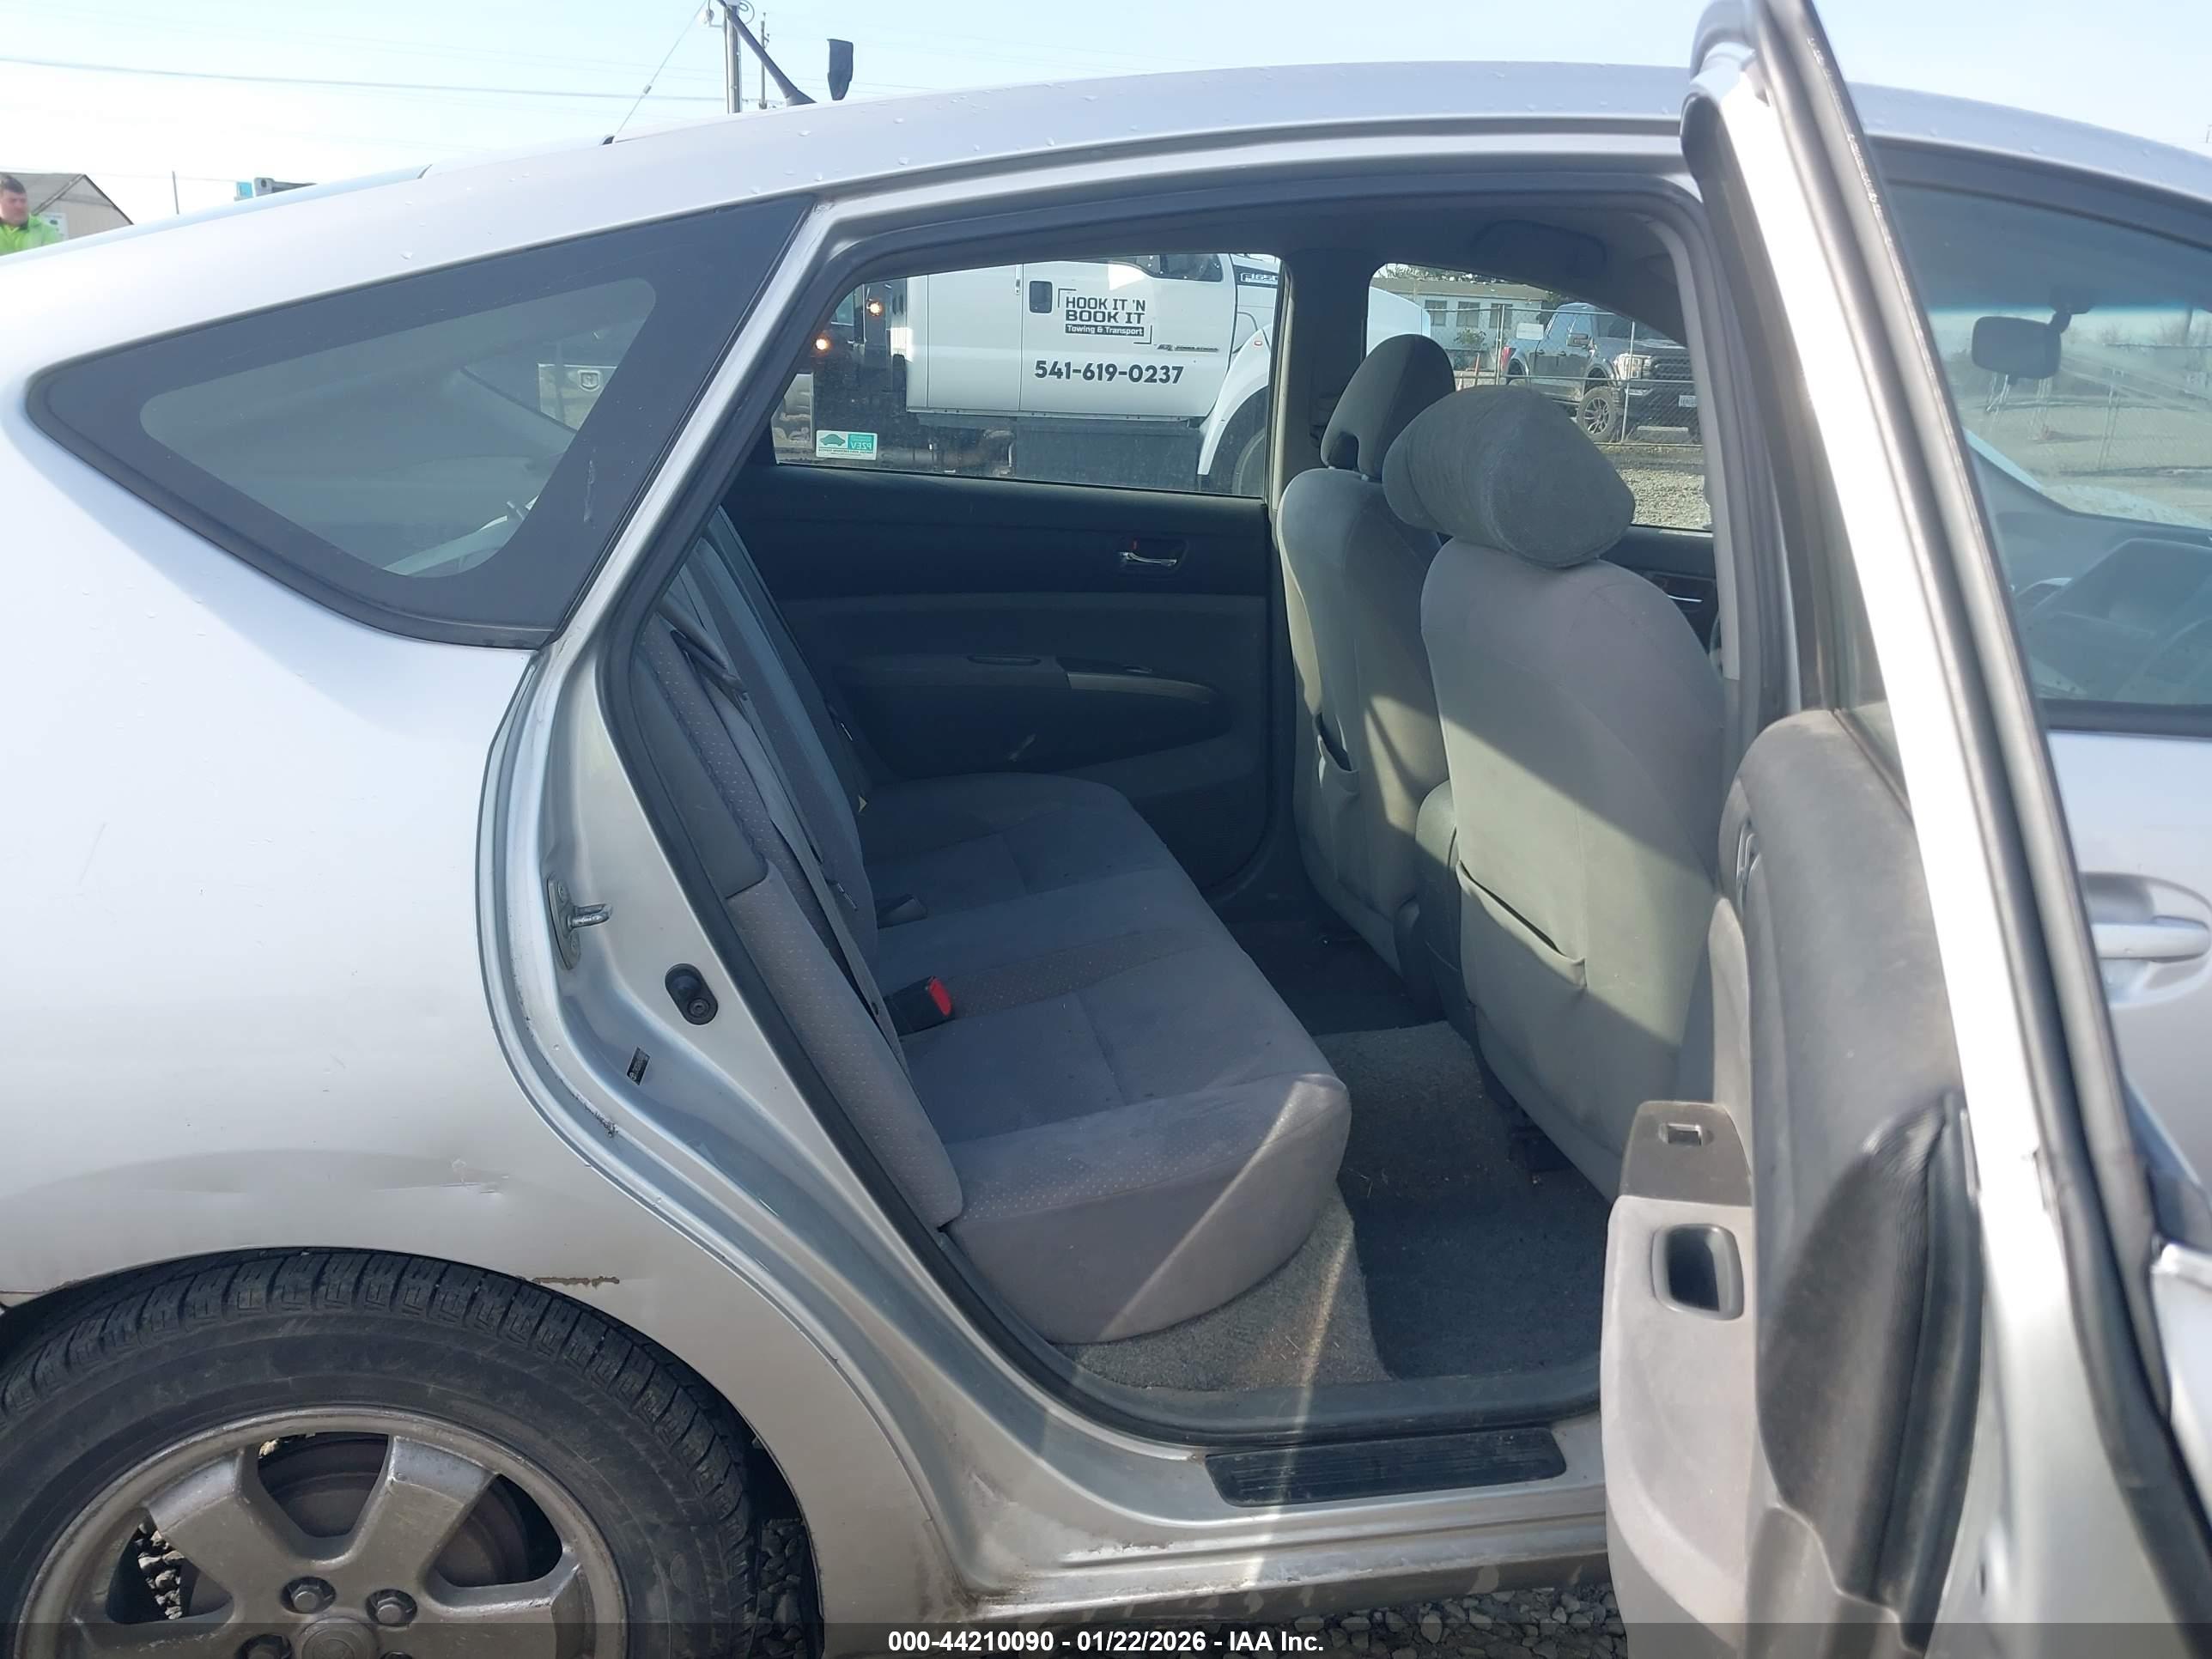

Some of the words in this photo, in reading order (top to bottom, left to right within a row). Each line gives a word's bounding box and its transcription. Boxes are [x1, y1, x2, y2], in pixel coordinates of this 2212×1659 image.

[1065, 296, 1108, 311] HOOK
[1112, 298, 1128, 312] IT
[1132, 300, 1146, 313] 'N
[1065, 309, 1120, 324] BOOK
[1125, 312, 1146, 325] IT
[1066, 325, 1096, 334] Towing
[1104, 326, 1143, 336] Transport
[1034, 360, 1184, 384] 541-619-0237
